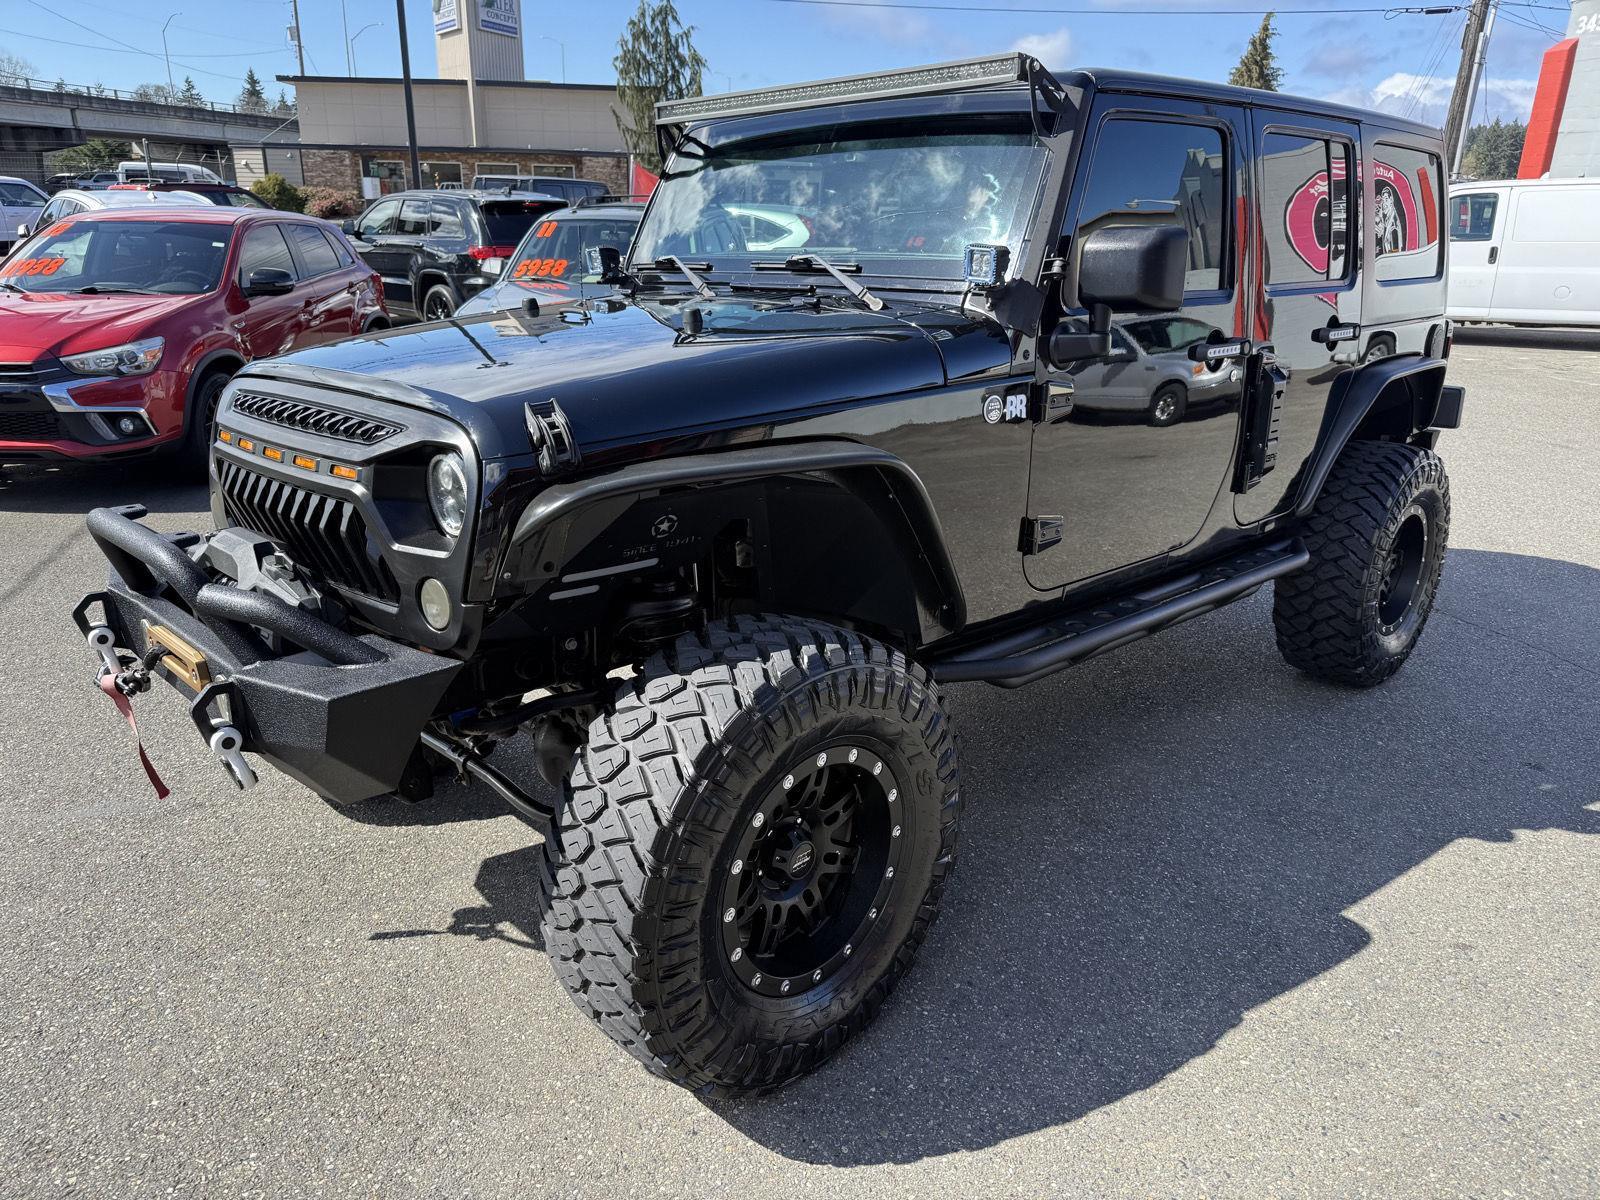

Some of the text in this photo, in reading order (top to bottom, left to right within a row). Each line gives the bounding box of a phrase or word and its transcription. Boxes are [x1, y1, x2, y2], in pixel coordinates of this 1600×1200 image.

[486, 10, 518, 25] CONCEPTS
[536, 221, 558, 238] 11
[513, 259, 568, 278] 5938
